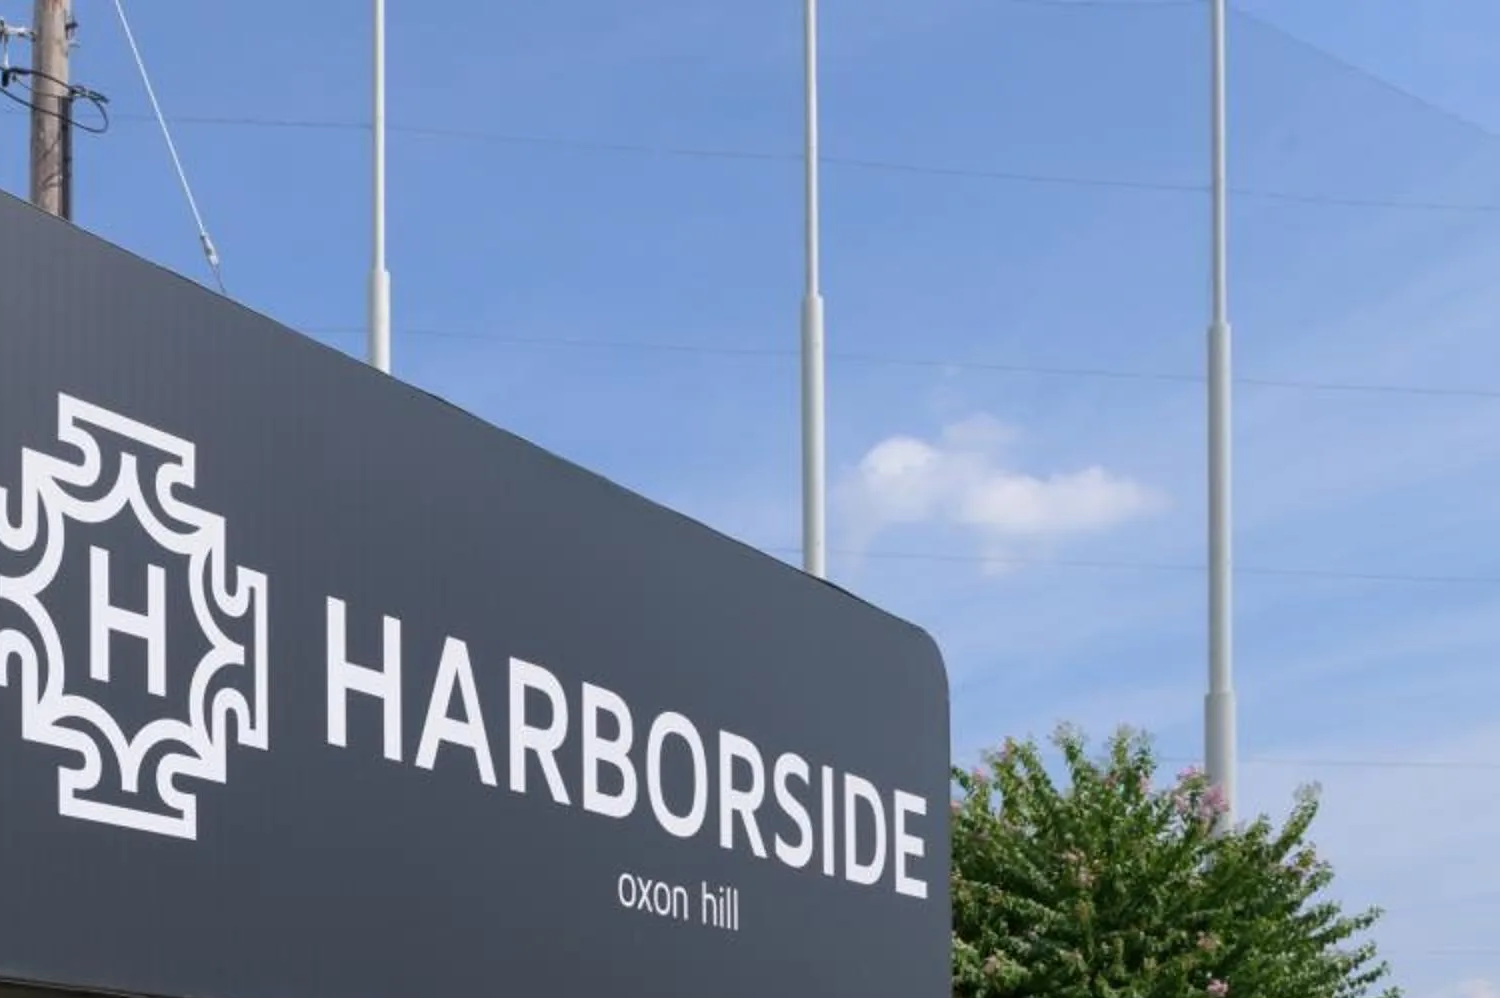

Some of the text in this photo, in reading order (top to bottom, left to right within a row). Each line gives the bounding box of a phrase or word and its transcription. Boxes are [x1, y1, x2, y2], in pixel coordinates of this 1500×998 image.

[88, 545, 167, 697] H
[325, 595, 929, 900] HARBORSIDE
[617, 873, 740, 932] oxon hill
